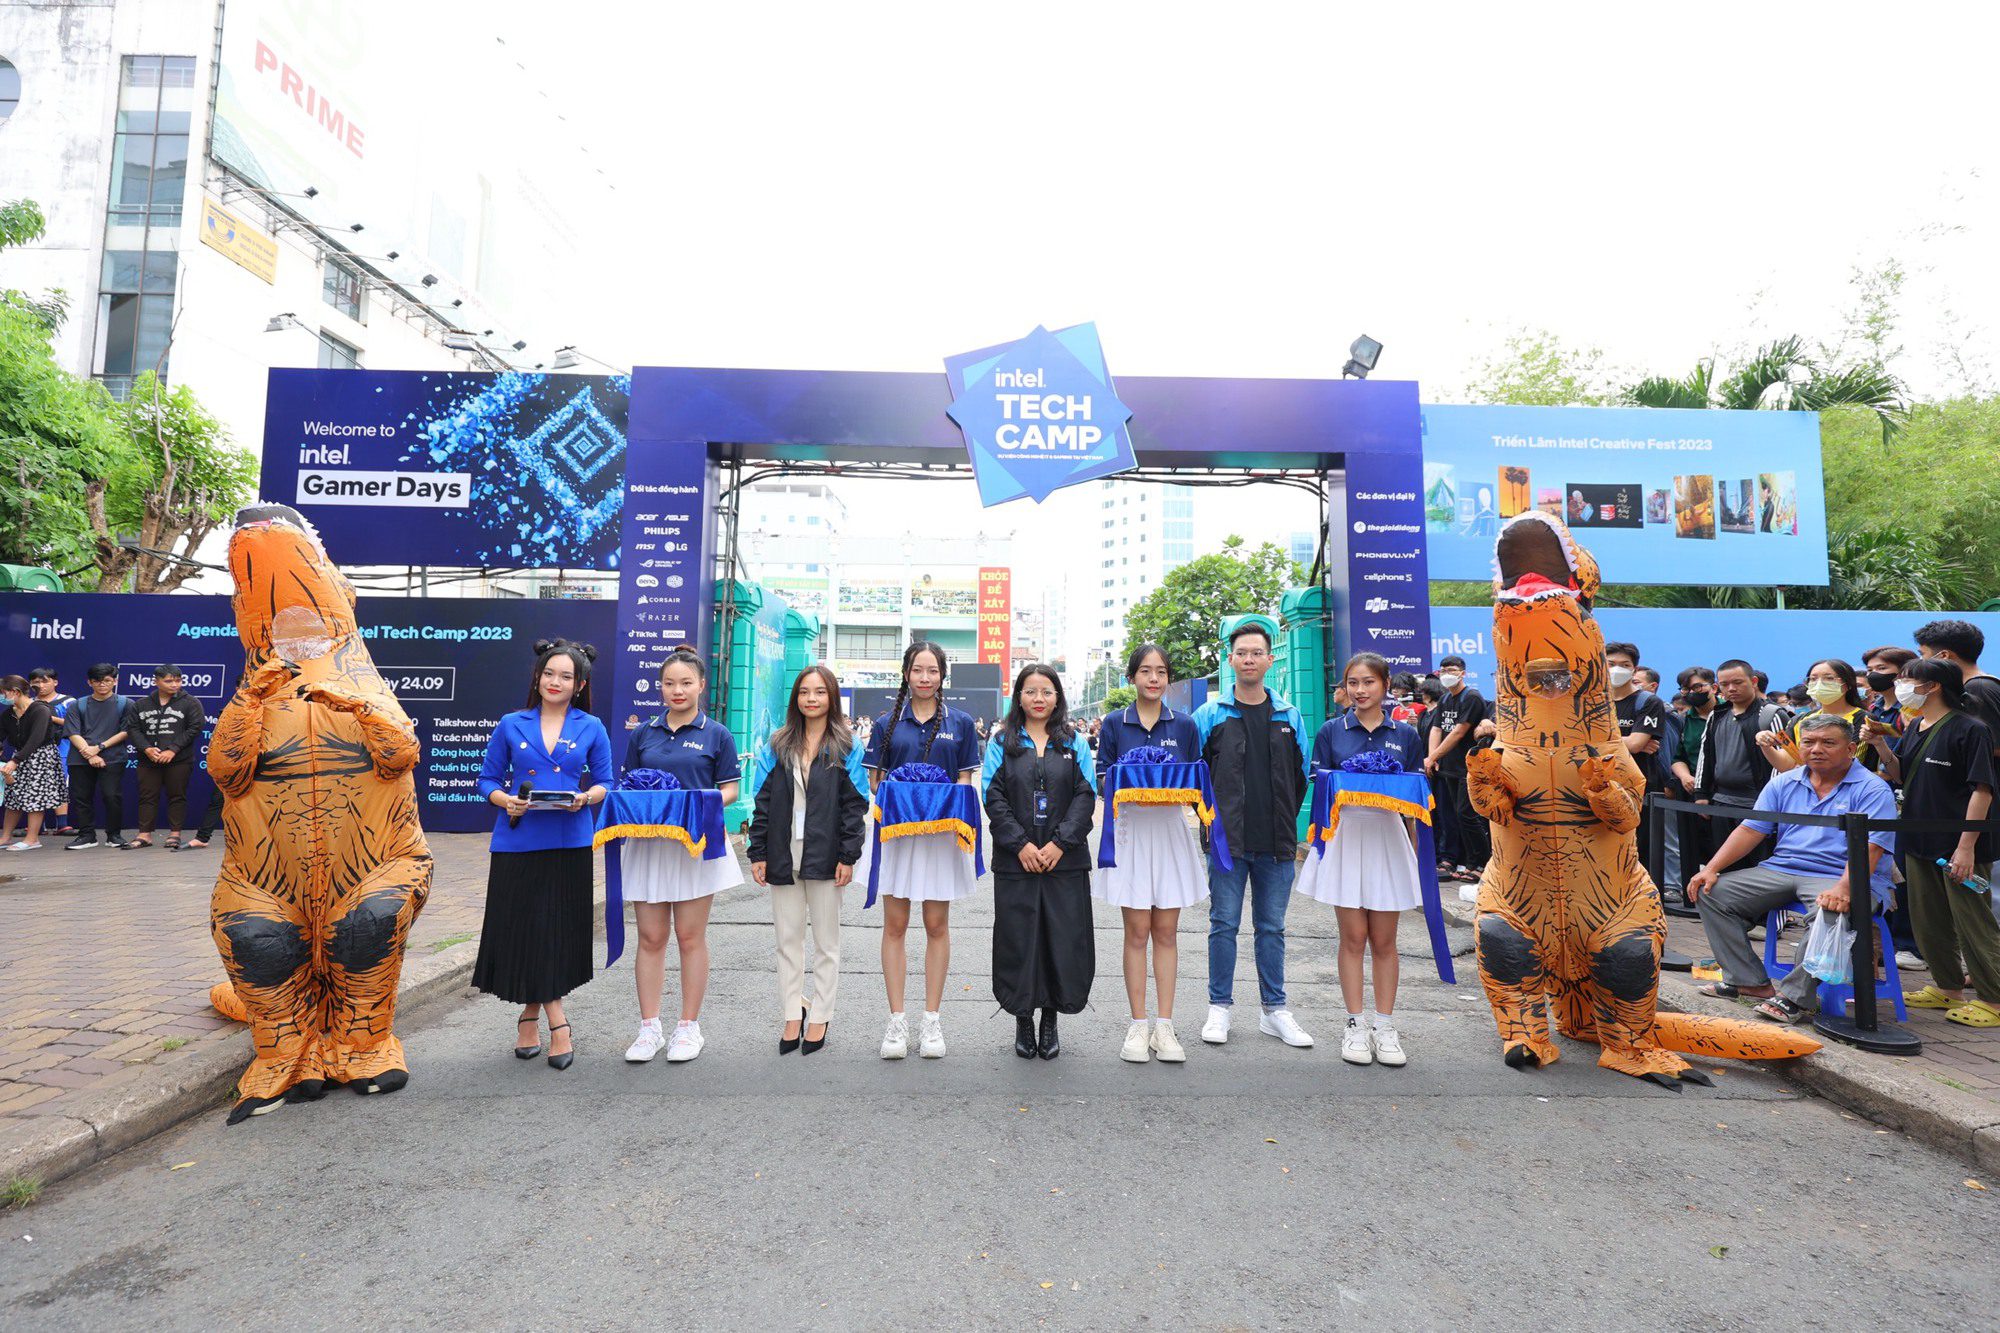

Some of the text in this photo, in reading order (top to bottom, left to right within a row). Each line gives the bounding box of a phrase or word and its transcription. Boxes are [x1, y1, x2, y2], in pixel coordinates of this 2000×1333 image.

[254, 38, 365, 159] PRIME
[995, 393, 1092, 420] TECH
[303, 421, 396, 437] Welcome to
[995, 423, 1102, 451] CAMP
[1559, 437, 1588, 449] Intel
[1590, 437, 1645, 450] Creative
[1647, 438, 1676, 450] Fest
[1678, 439, 1713, 451] 2023
[303, 474, 461, 502] Gamer Days
[644, 527, 680, 535] PHILIPS
[177, 622, 239, 639] Agenda
[380, 625, 419, 639] Tech
[421, 625, 469, 642] Camp
[470, 626, 513, 641] 2023
[129, 673, 212, 689] Ngà 3.09
[401, 677, 444, 690] 24.09
[433, 718, 477, 727] Talkshow
[444, 733, 460, 742] các
[429, 778, 448, 788] Rap
[449, 778, 474, 787] show
